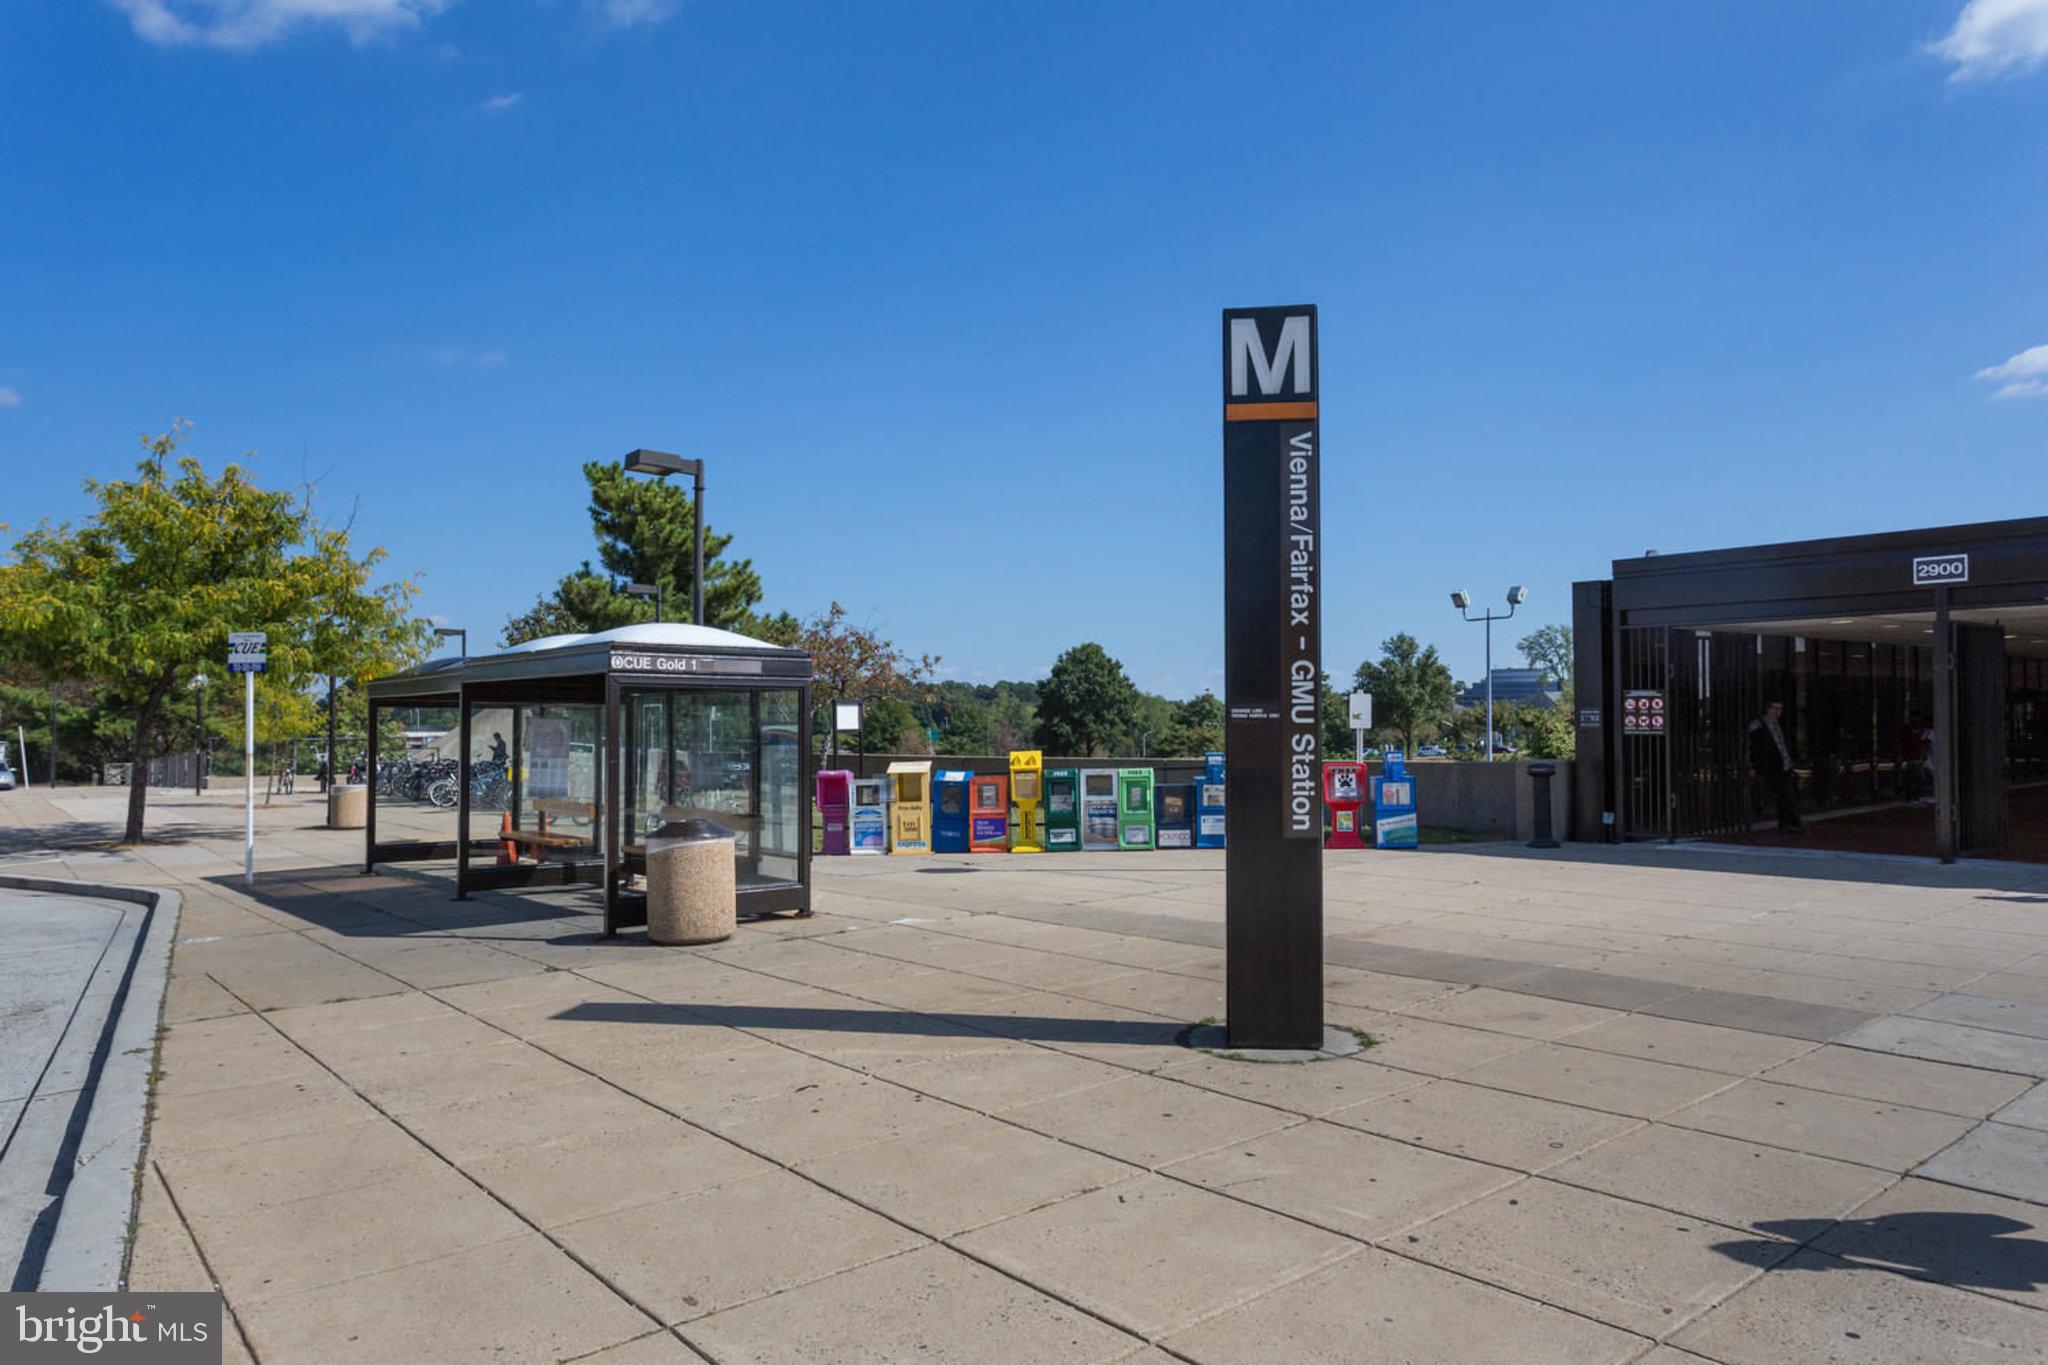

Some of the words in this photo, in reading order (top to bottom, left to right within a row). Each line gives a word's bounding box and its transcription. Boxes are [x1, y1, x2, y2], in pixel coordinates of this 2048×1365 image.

[1230, 315, 1310, 396] M
[1288, 430, 1314, 625] Vienna/Fairfax
[1917, 561, 1963, 579] 2900
[235, 642, 260, 655] CUE
[656, 657, 686, 671] Gold
[690, 659, 697, 671] 1
[1289, 659, 1315, 725] GMU
[1290, 733, 1315, 830] Station
